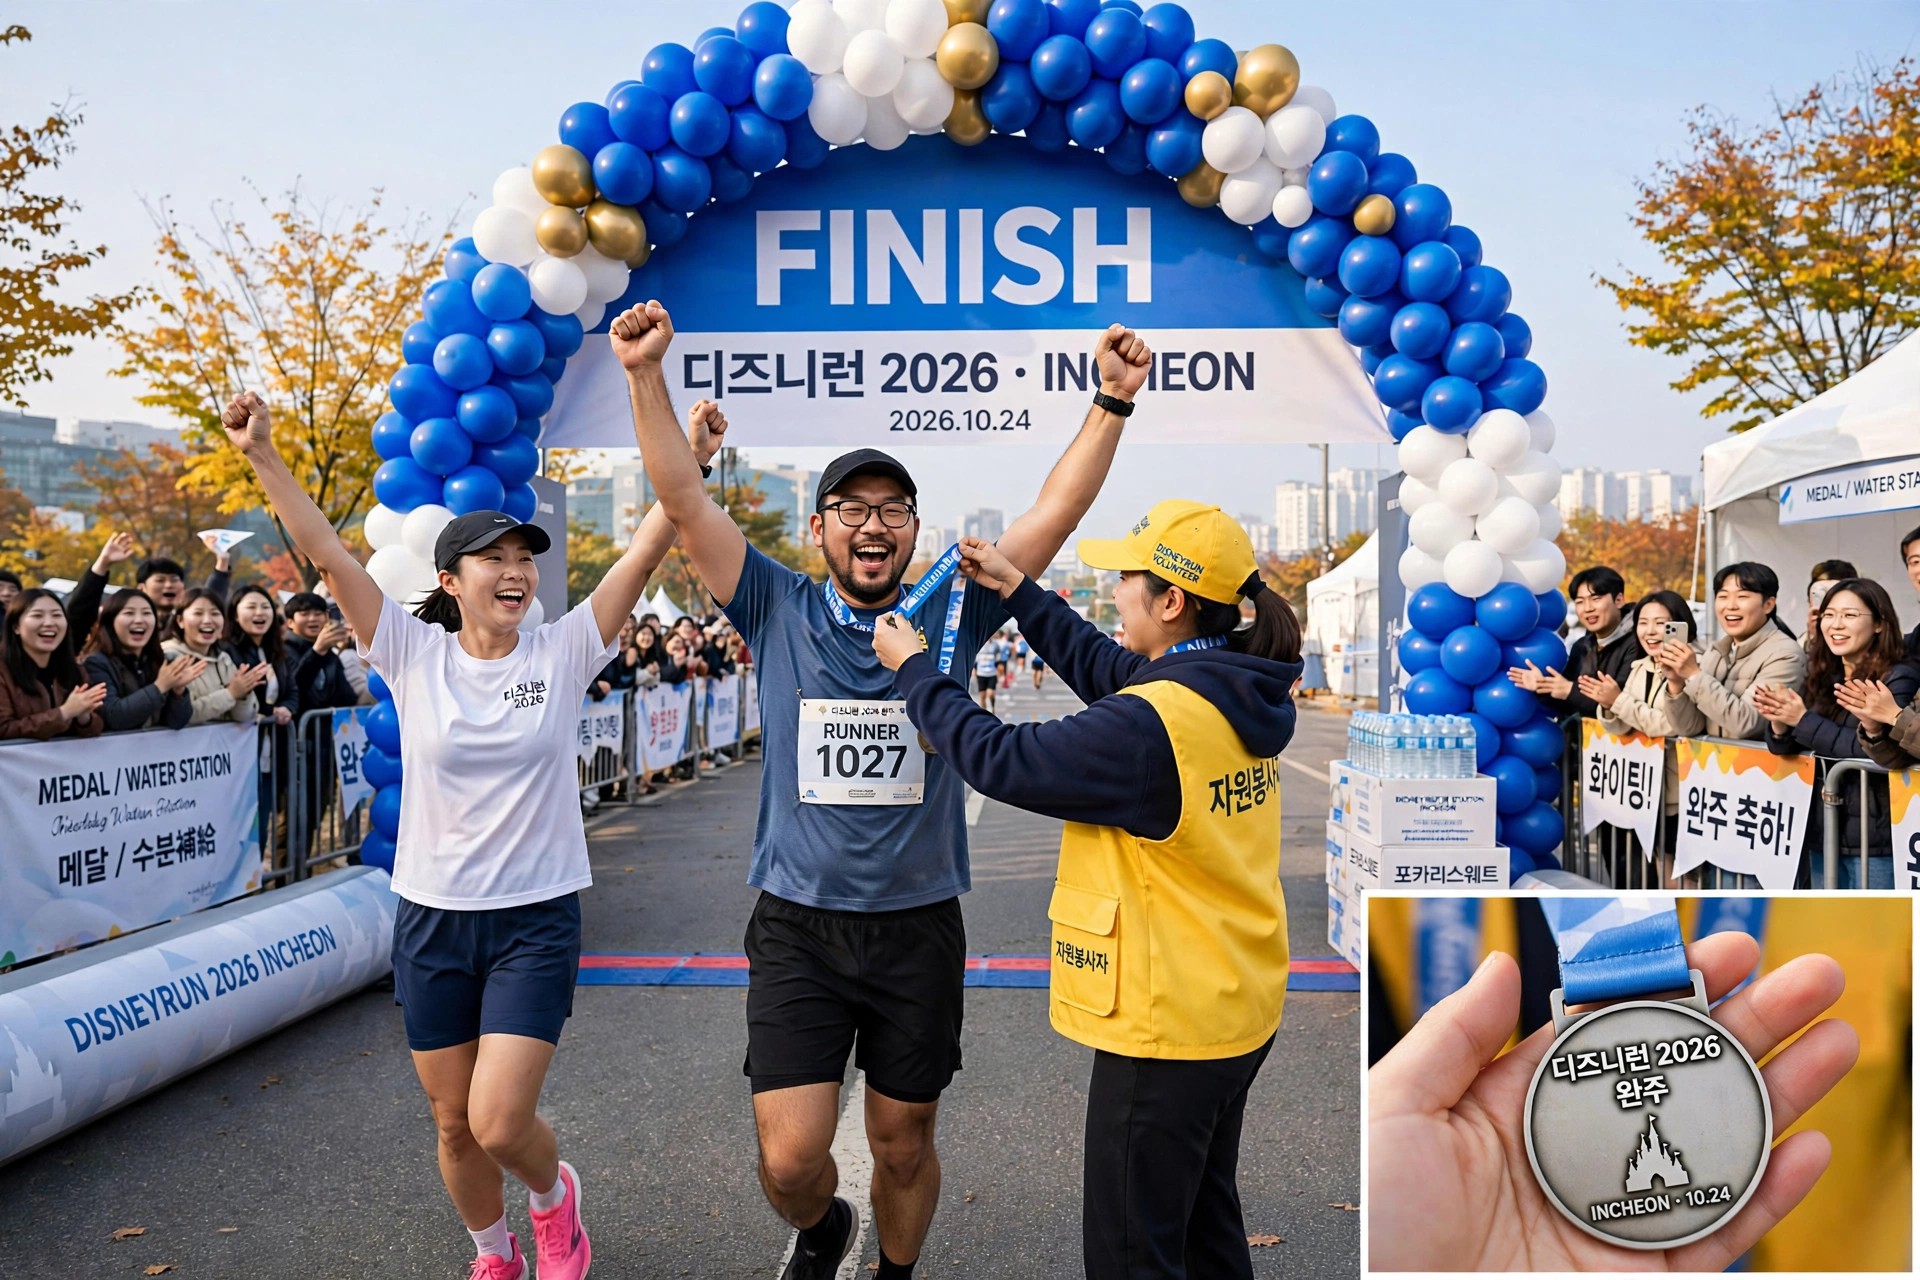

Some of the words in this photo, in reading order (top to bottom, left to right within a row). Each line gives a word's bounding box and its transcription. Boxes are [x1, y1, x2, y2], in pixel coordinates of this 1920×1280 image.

[756, 207, 1152, 306] FINISH
[683, 349, 865, 399] 디즈니런
[880, 352, 998, 393] 2026
[1044, 352, 1256, 391] INEON
[889, 408, 1031, 432] 2026.10.24
[1806, 485, 1843, 503] MEDAL
[1853, 475, 1895, 496] WATER
[514, 695, 545, 709] 2026
[823, 722, 900, 740] RUNNER
[38, 771, 110, 805] MEDAL
[125, 761, 176, 791] WATER
[179, 752, 232, 783] STATION
[816, 744, 908, 779] 1027
[1588, 752, 1654, 810] 화이팅!
[1686, 785, 1728, 841] 완주
[1734, 794, 1795, 857] 축하!
[58, 846, 109, 888] 메달
[1394, 865, 1499, 884] 포카리스웨트
[1055, 940, 1109, 975] 자원봉사자
[64, 972, 210, 1053] DISNEYRUN
[207, 953, 260, 997] 2026
[258, 924, 338, 977] INCHEON
[1551, 1045, 1651, 1083] 디즈니런
[1655, 1033, 1722, 1067] 2026
[1615, 1074, 1670, 1110] 완주
[1590, 1193, 1671, 1222] INCHEON
[1684, 1184, 1732, 1207] 10.24
